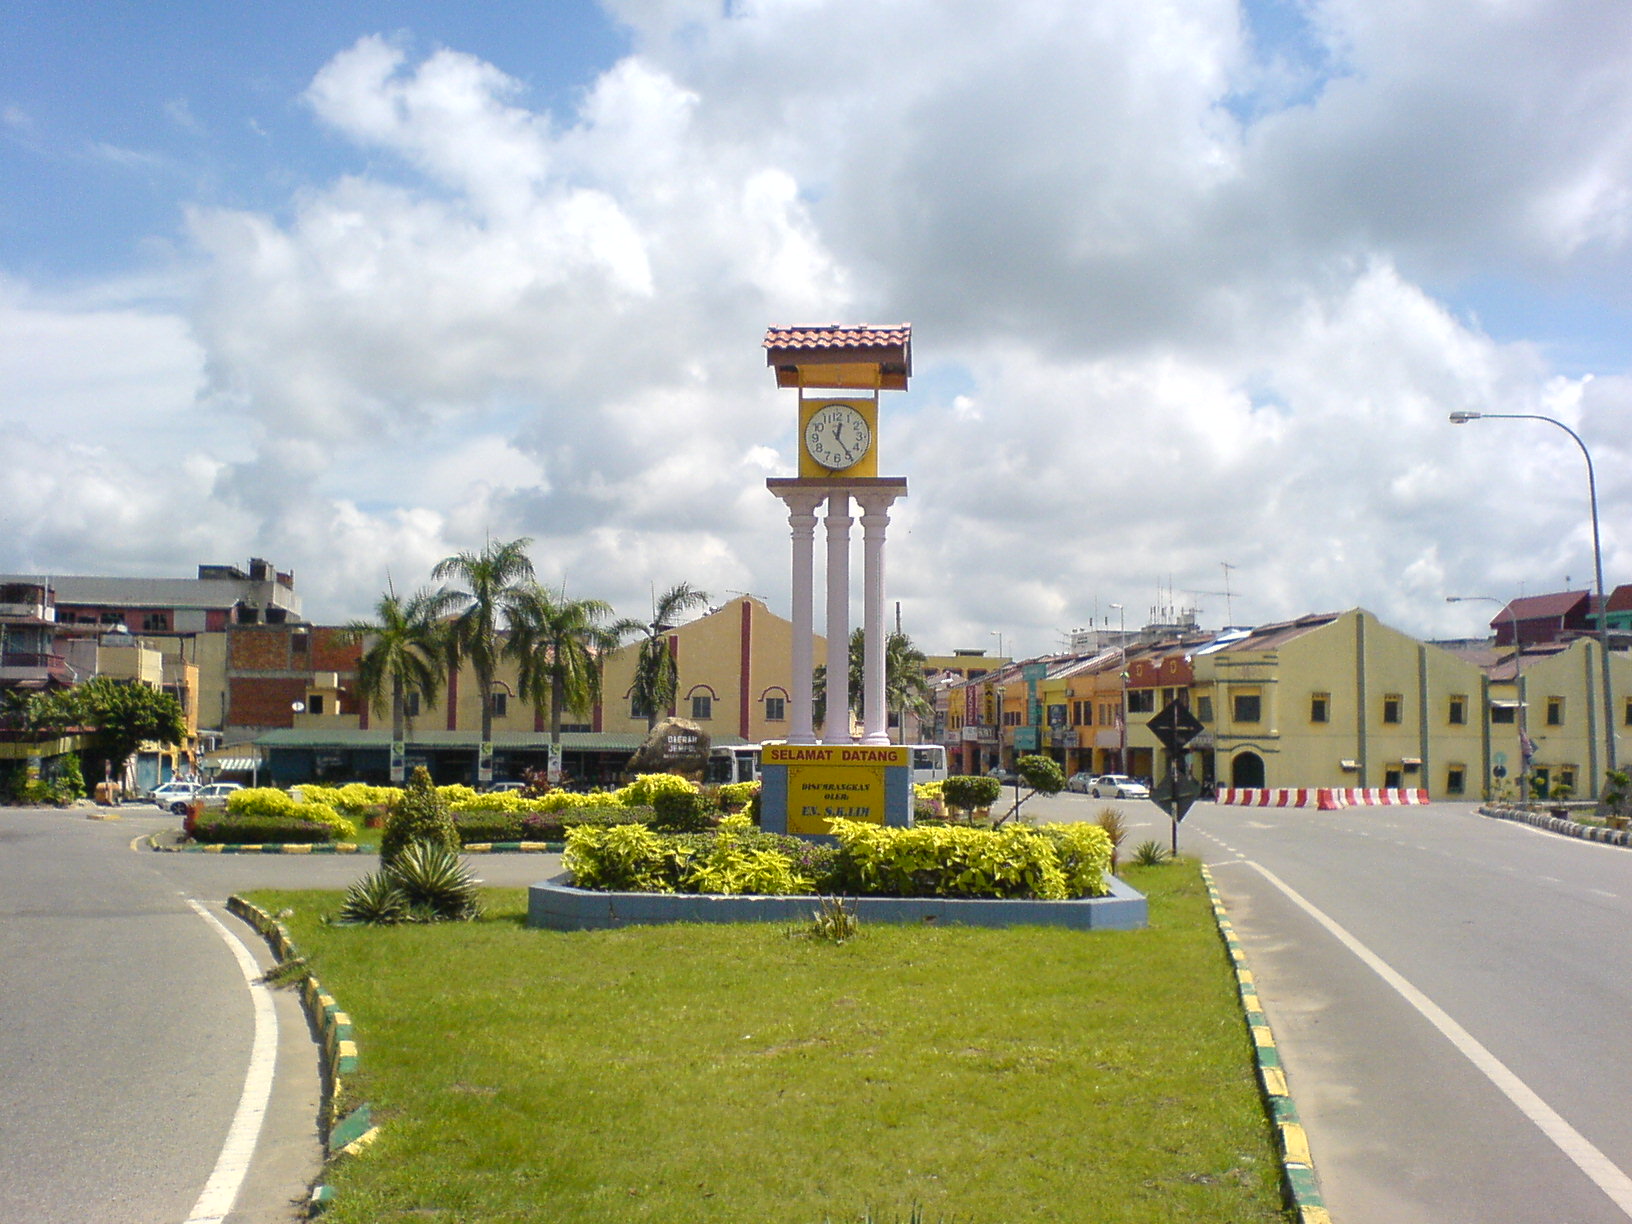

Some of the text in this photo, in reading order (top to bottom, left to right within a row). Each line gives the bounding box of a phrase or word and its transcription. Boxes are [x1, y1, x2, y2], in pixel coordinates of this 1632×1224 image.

[823, 415, 832, 424] 11
[832, 412, 843, 422] 12
[813, 422, 825, 432] 10
[853, 421, 860, 431] 2
[811, 433, 819, 443] 9
[855, 431, 863, 441] 3
[815, 443, 823, 453] 8
[853, 442, 860, 451] 4
[824, 451, 831, 461] 7
[833, 453, 841, 463] 6
[667, 735, 698, 743] DAERAH
[771, 749, 898, 762] SELAMAT DATANG
